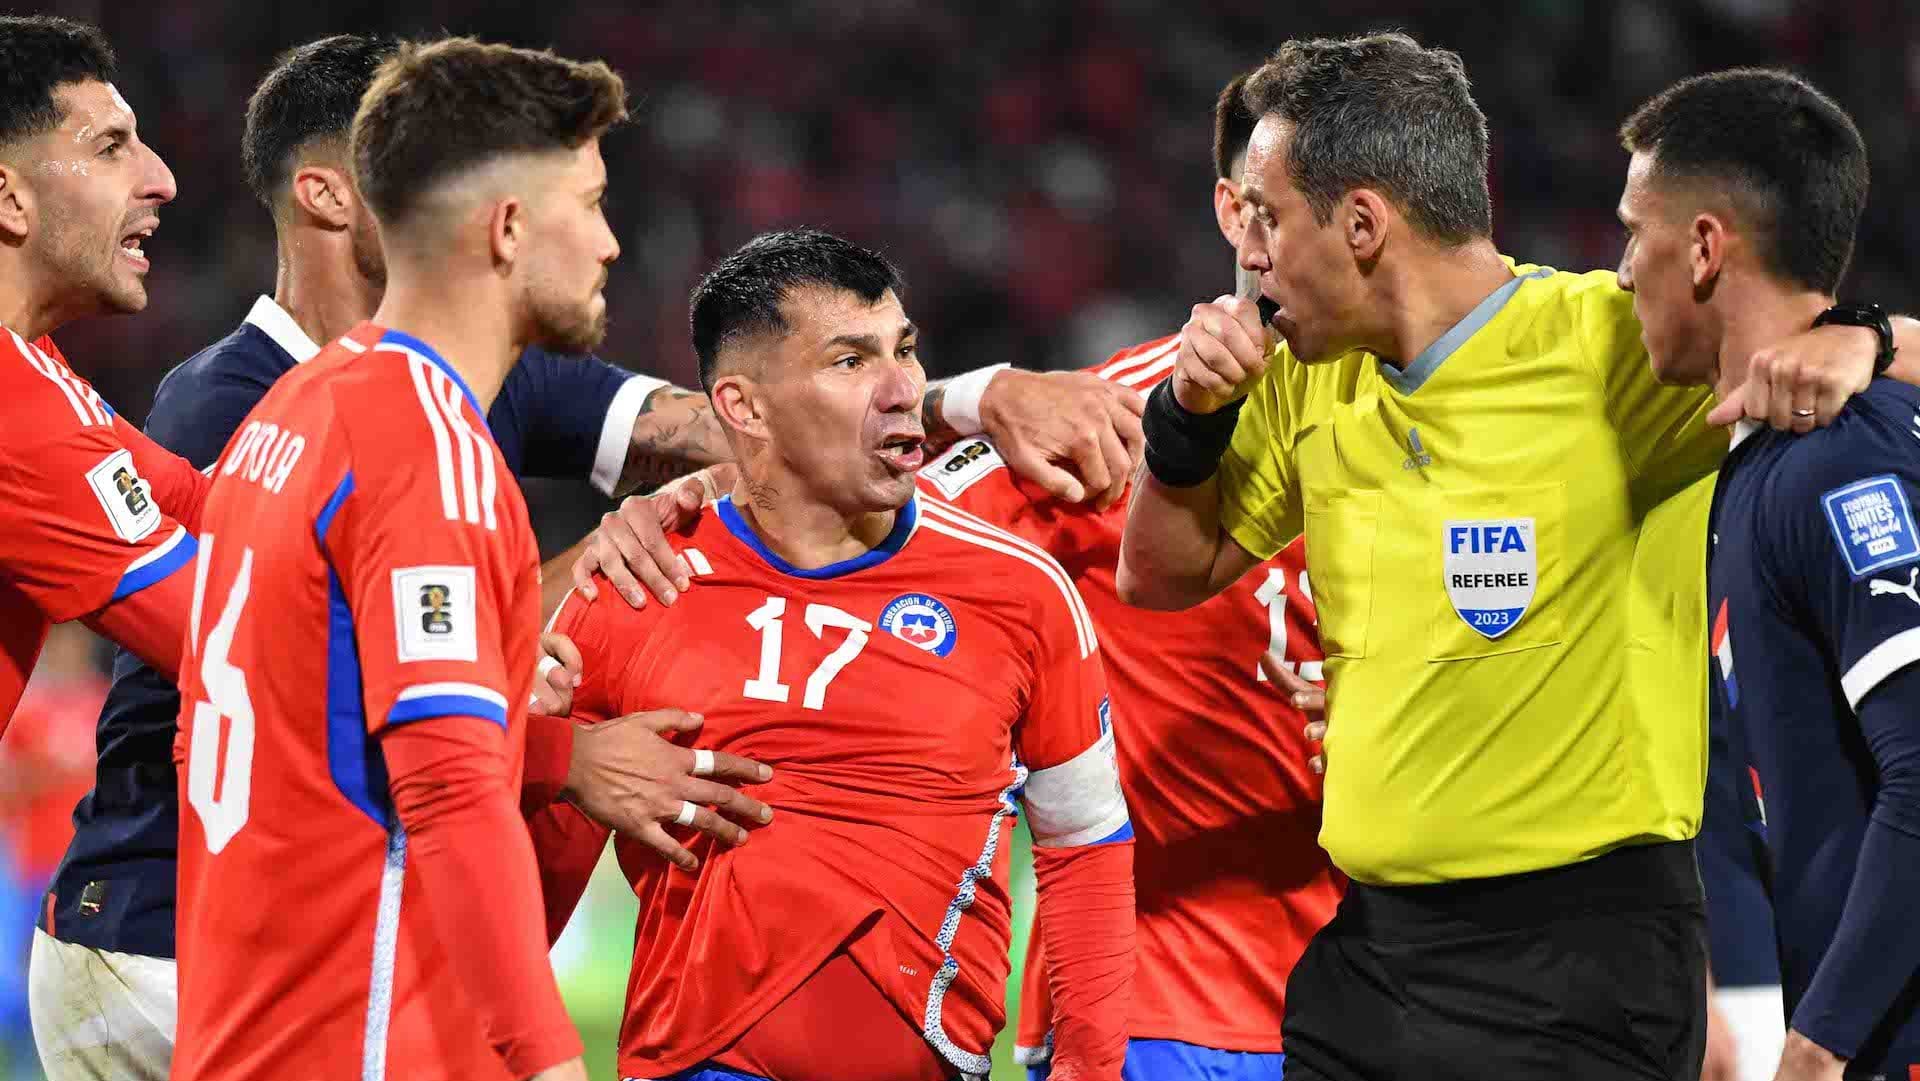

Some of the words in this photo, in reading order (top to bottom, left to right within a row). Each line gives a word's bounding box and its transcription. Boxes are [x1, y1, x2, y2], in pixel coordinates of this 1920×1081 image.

[1846, 505, 1895, 531] UNITES
[1451, 526, 1527, 554] FIFA
[1452, 573, 1529, 588] REFEREE
[882, 597, 921, 628] FEDERACION
[925, 599, 937, 609] DE
[1474, 612, 1510, 626] 2023
[743, 595, 873, 711] 17
